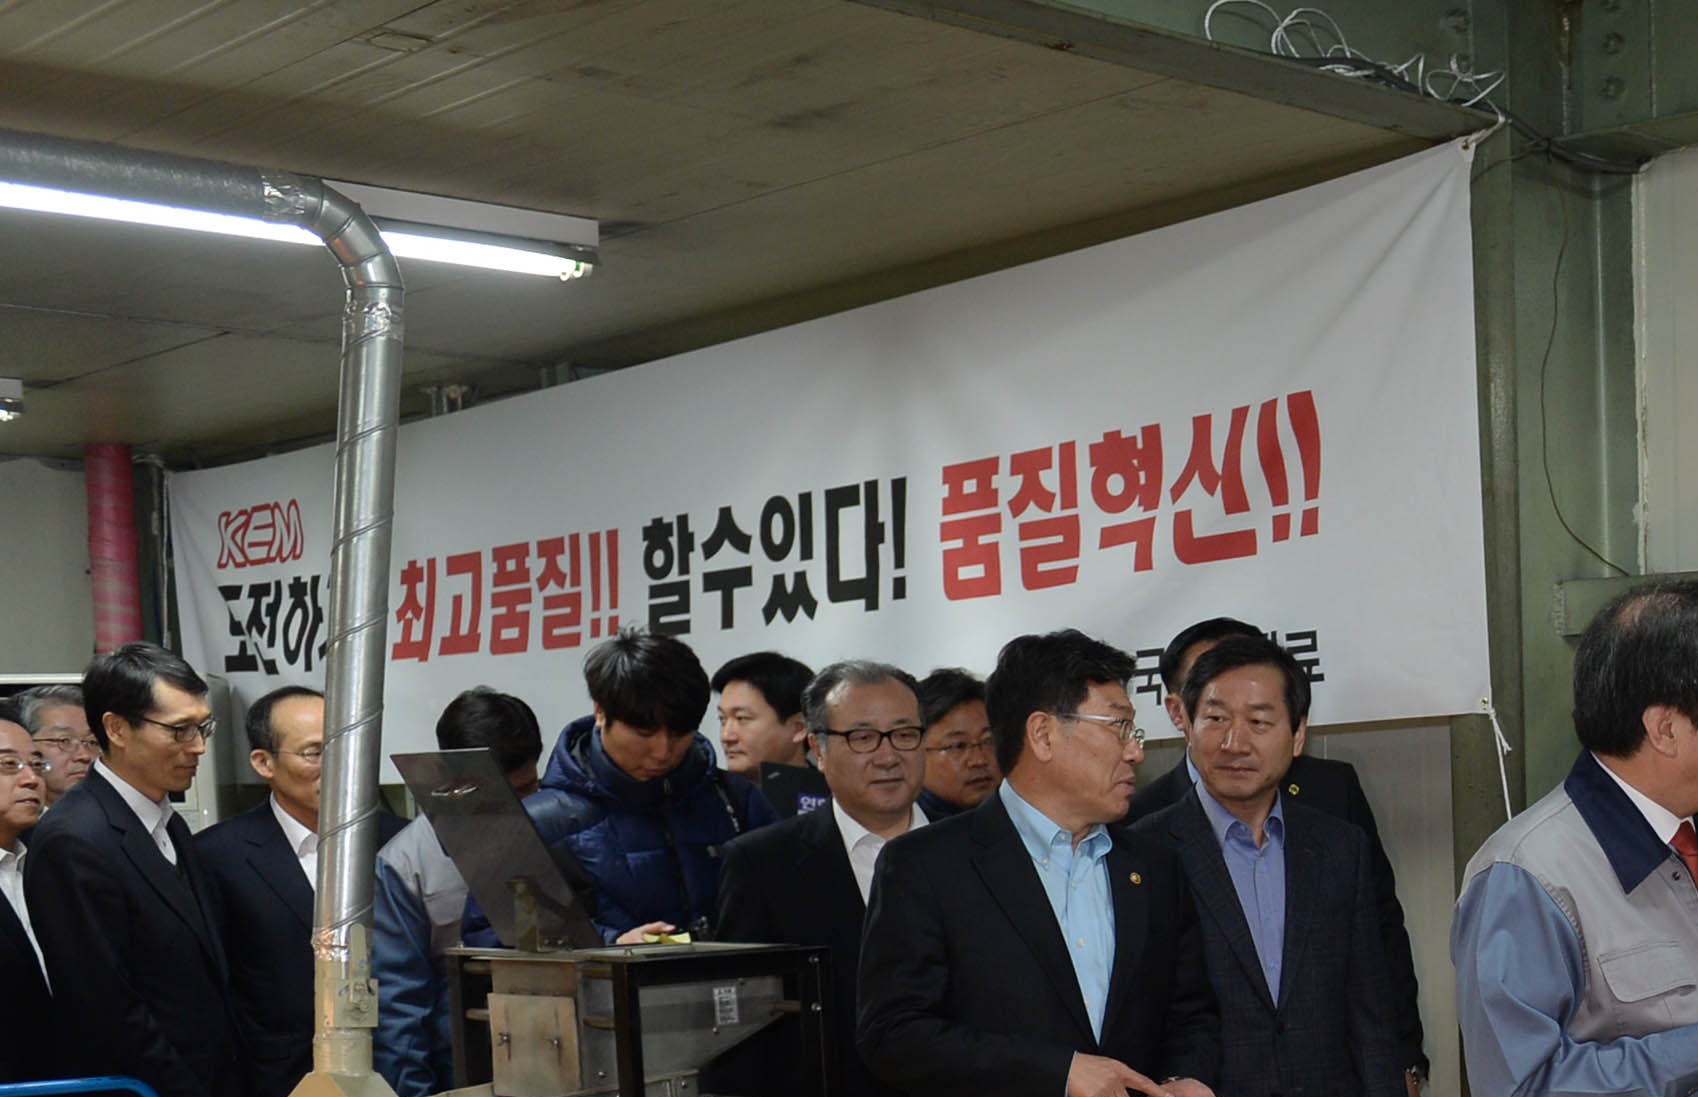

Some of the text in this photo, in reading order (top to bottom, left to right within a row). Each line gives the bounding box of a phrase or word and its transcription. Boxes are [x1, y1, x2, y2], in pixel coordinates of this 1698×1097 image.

[217, 499, 304, 569] KEM
[218, 390, 1321, 675] 도전하 최고품질!! 할수있다! 품질혁신!!
